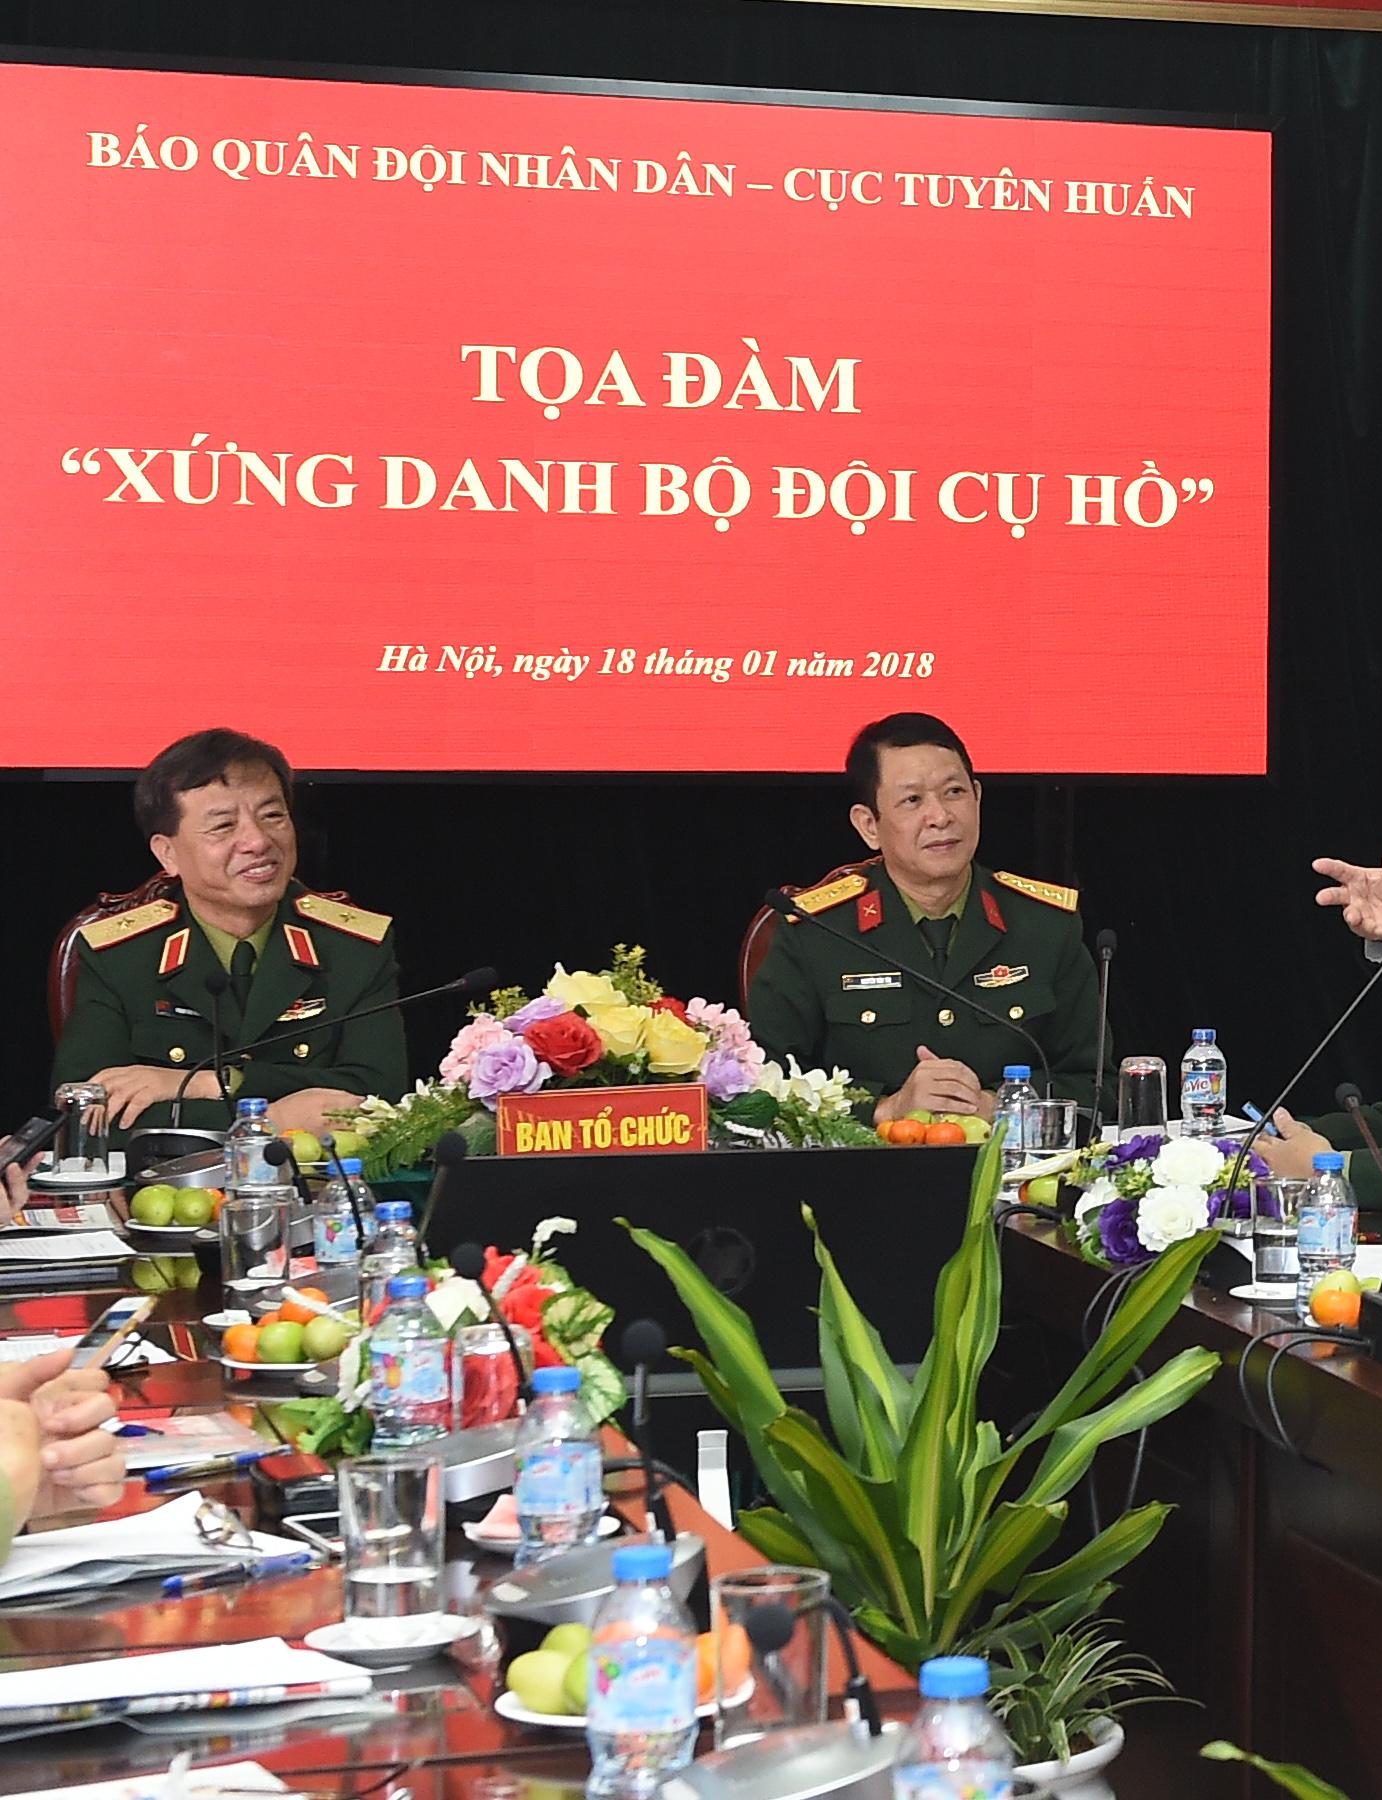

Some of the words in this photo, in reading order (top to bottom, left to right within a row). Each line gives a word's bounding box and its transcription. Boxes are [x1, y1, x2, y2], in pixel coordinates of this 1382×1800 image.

[86, 123, 199, 172] BÁO
[212, 131, 361, 181] QUÂN
[372, 144, 467, 192] ĐỘI
[477, 145, 622, 193] NHÂN
[632, 150, 737, 197] DÂN
[783, 167, 883, 211] CỤC
[894, 167, 1054, 213] TUYÊN
[1063, 176, 1196, 219] HUẤN
[461, 345, 647, 420] TỌA
[662, 337, 862, 414] ĐÀM
[61, 432, 358, 508] “XỨNG
[379, 456, 619, 515] DANH
[638, 456, 751, 533] BỘ
[771, 460, 918, 536] ĐỘI
[938, 471, 1046, 539] CỤ
[1064, 460, 1214, 528] HỒ”
[375, 645, 428, 672] Hà
[434, 645, 503, 680] Nội,
[512, 646, 590, 682] ngày
[597, 648, 636, 675] 18
[643, 647, 735, 683] tháng
[742, 649, 777, 677] 01
[786, 651, 854, 678] năm
[861, 651, 935, 679] 2018
[516, 1120, 573, 1153] BAN
[578, 1105, 613, 1149] TỔ
[619, 1105, 691, 1148] CHỨC
